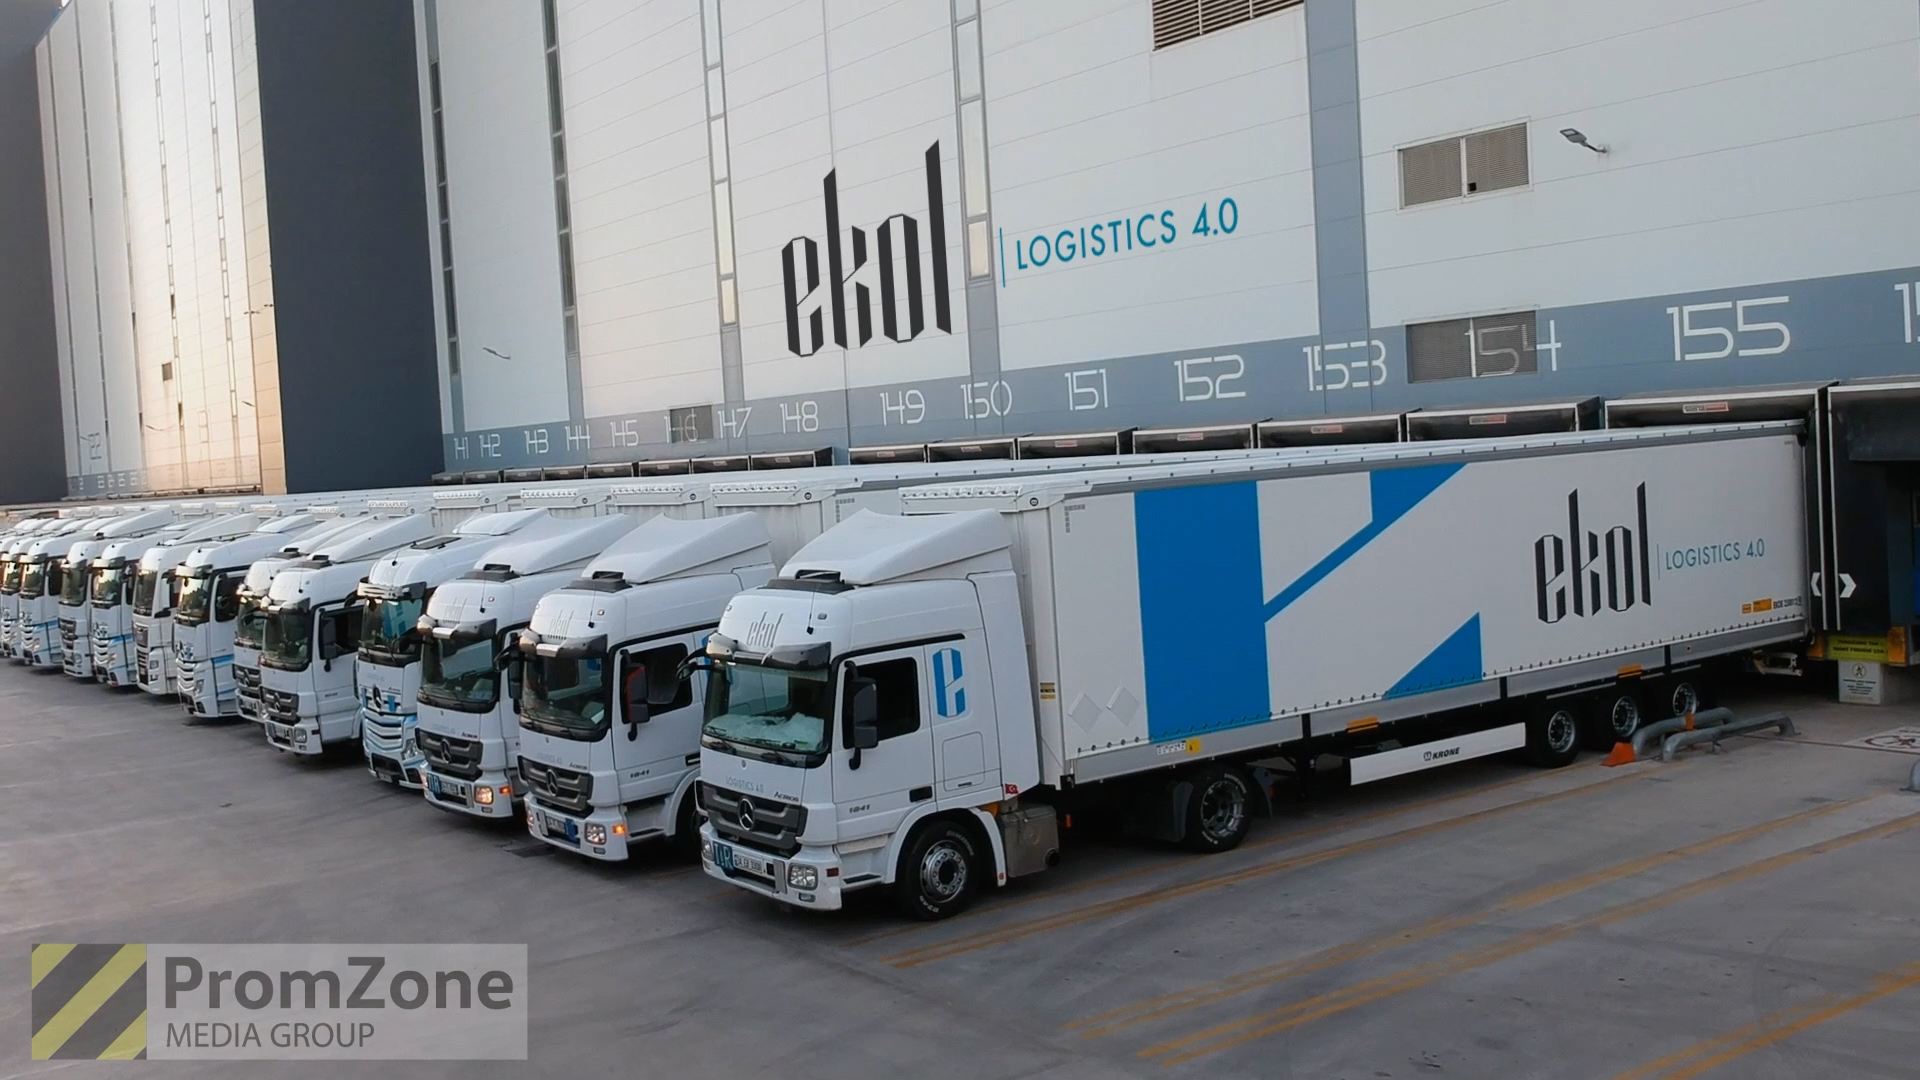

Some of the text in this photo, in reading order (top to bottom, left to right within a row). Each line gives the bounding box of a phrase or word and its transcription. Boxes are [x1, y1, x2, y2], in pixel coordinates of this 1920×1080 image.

[782, 139, 952, 357] ekol
[1017, 197, 1239, 270] LOGISTICS 4.0
[1464, 318, 1562, 378] 154
[1666, 295, 1791, 361] 155
[1174, 354, 1247, 402] 152
[1303, 339, 1388, 392] 153
[879, 389, 926, 426] 149
[960, 379, 1013, 420] 150
[1064, 368, 1109, 411] 151
[610, 419, 639, 448] 145
[717, 407, 752, 439] 147
[779, 400, 819, 433] 148
[1535, 481, 1651, 623] ekol
[1665, 537, 1766, 571] LOGISTICS 4.0
[1432, 746, 1461, 760] KRONE
